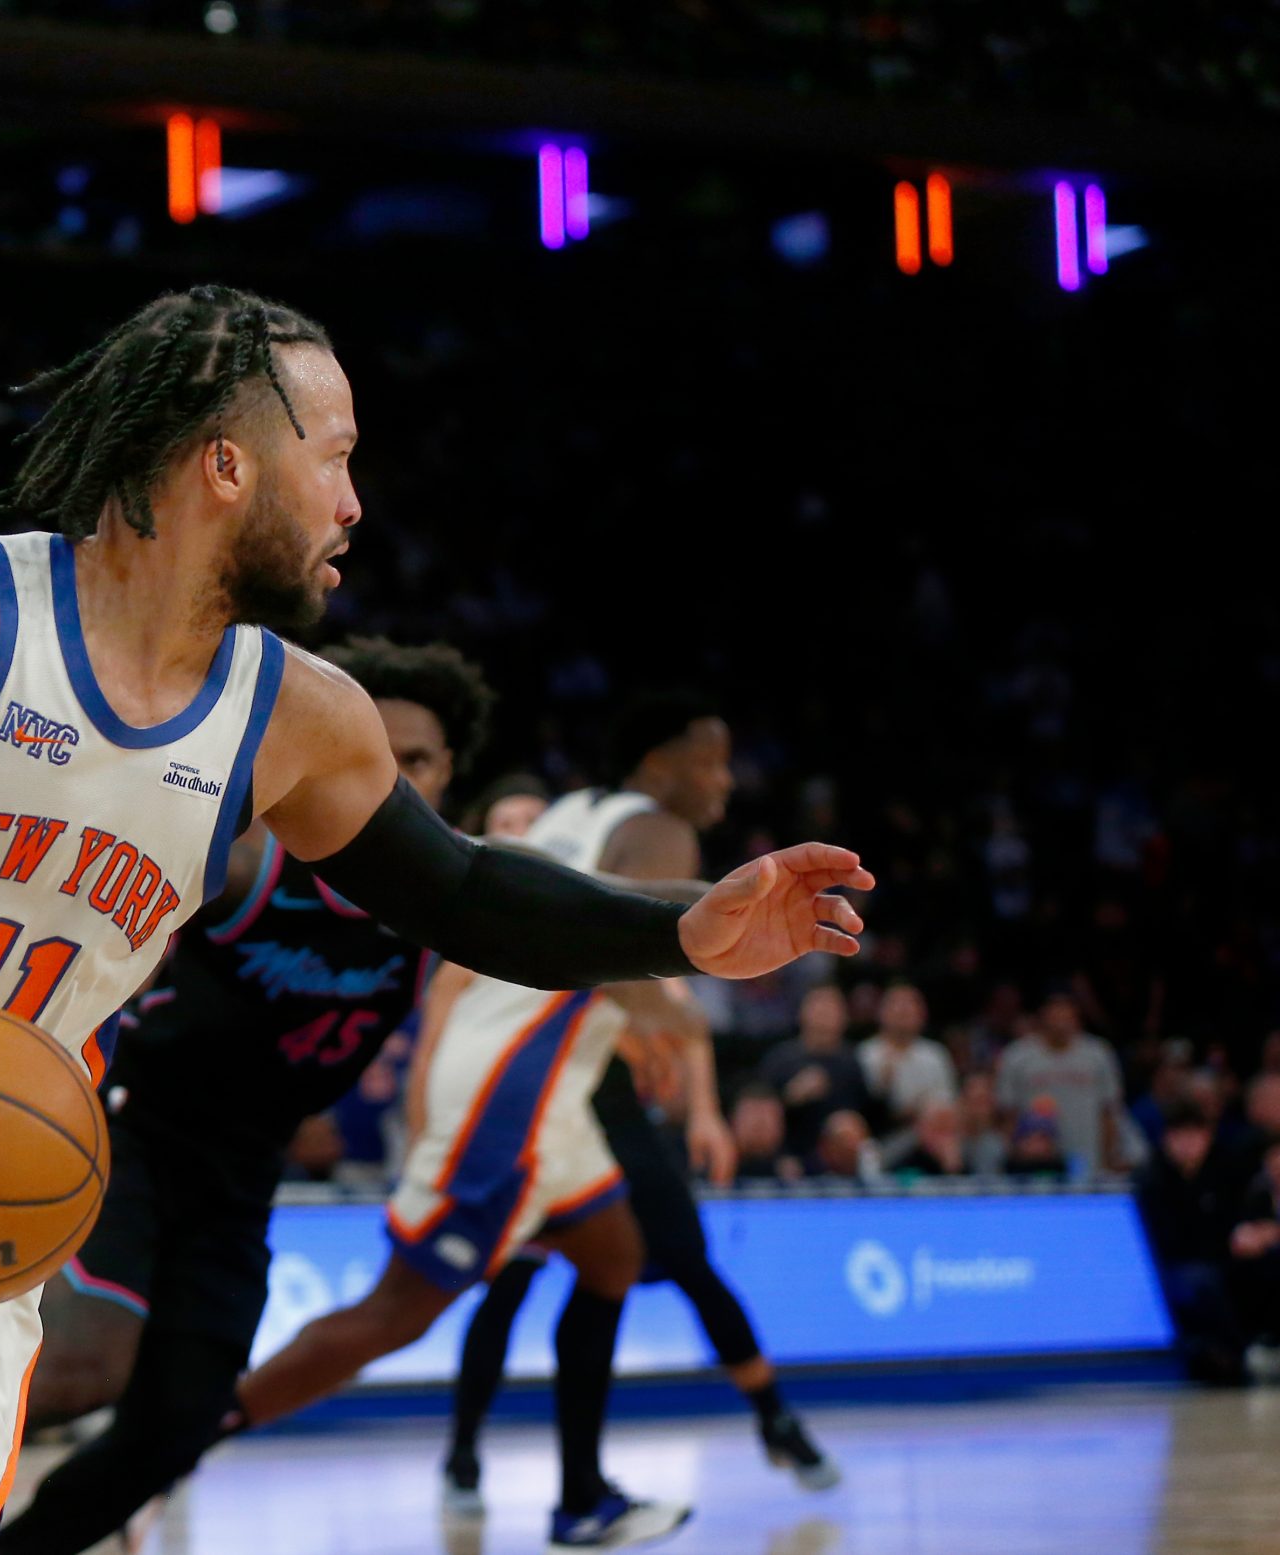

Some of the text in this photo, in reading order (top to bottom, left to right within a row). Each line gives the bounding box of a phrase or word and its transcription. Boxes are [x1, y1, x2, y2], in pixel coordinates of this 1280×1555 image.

[162, 771, 223, 797] abu dhabi
[169, 761, 200, 775] experience
[58, 826, 180, 952] YORK
[278, 1008, 381, 1067] 45
